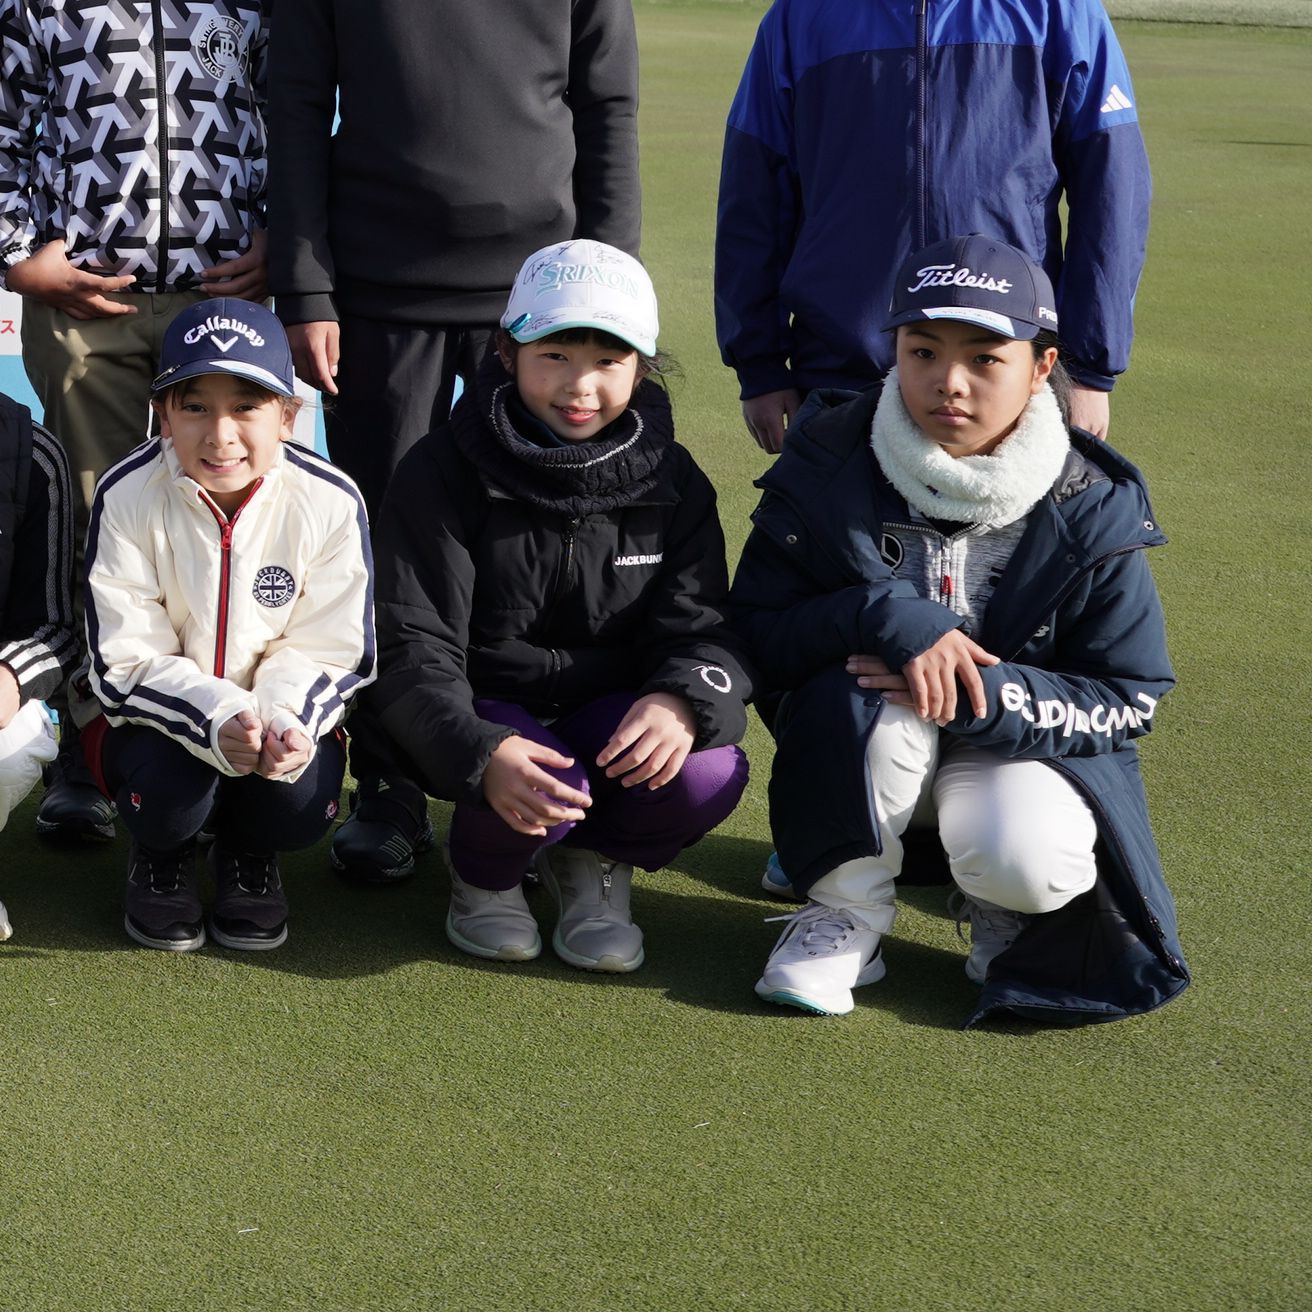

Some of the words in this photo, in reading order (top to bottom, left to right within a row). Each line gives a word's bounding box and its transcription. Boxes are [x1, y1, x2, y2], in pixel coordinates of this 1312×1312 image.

[537, 261, 640, 298] SRIXON
[908, 263, 1013, 294] Titleist
[184, 315, 266, 348] Callaway
